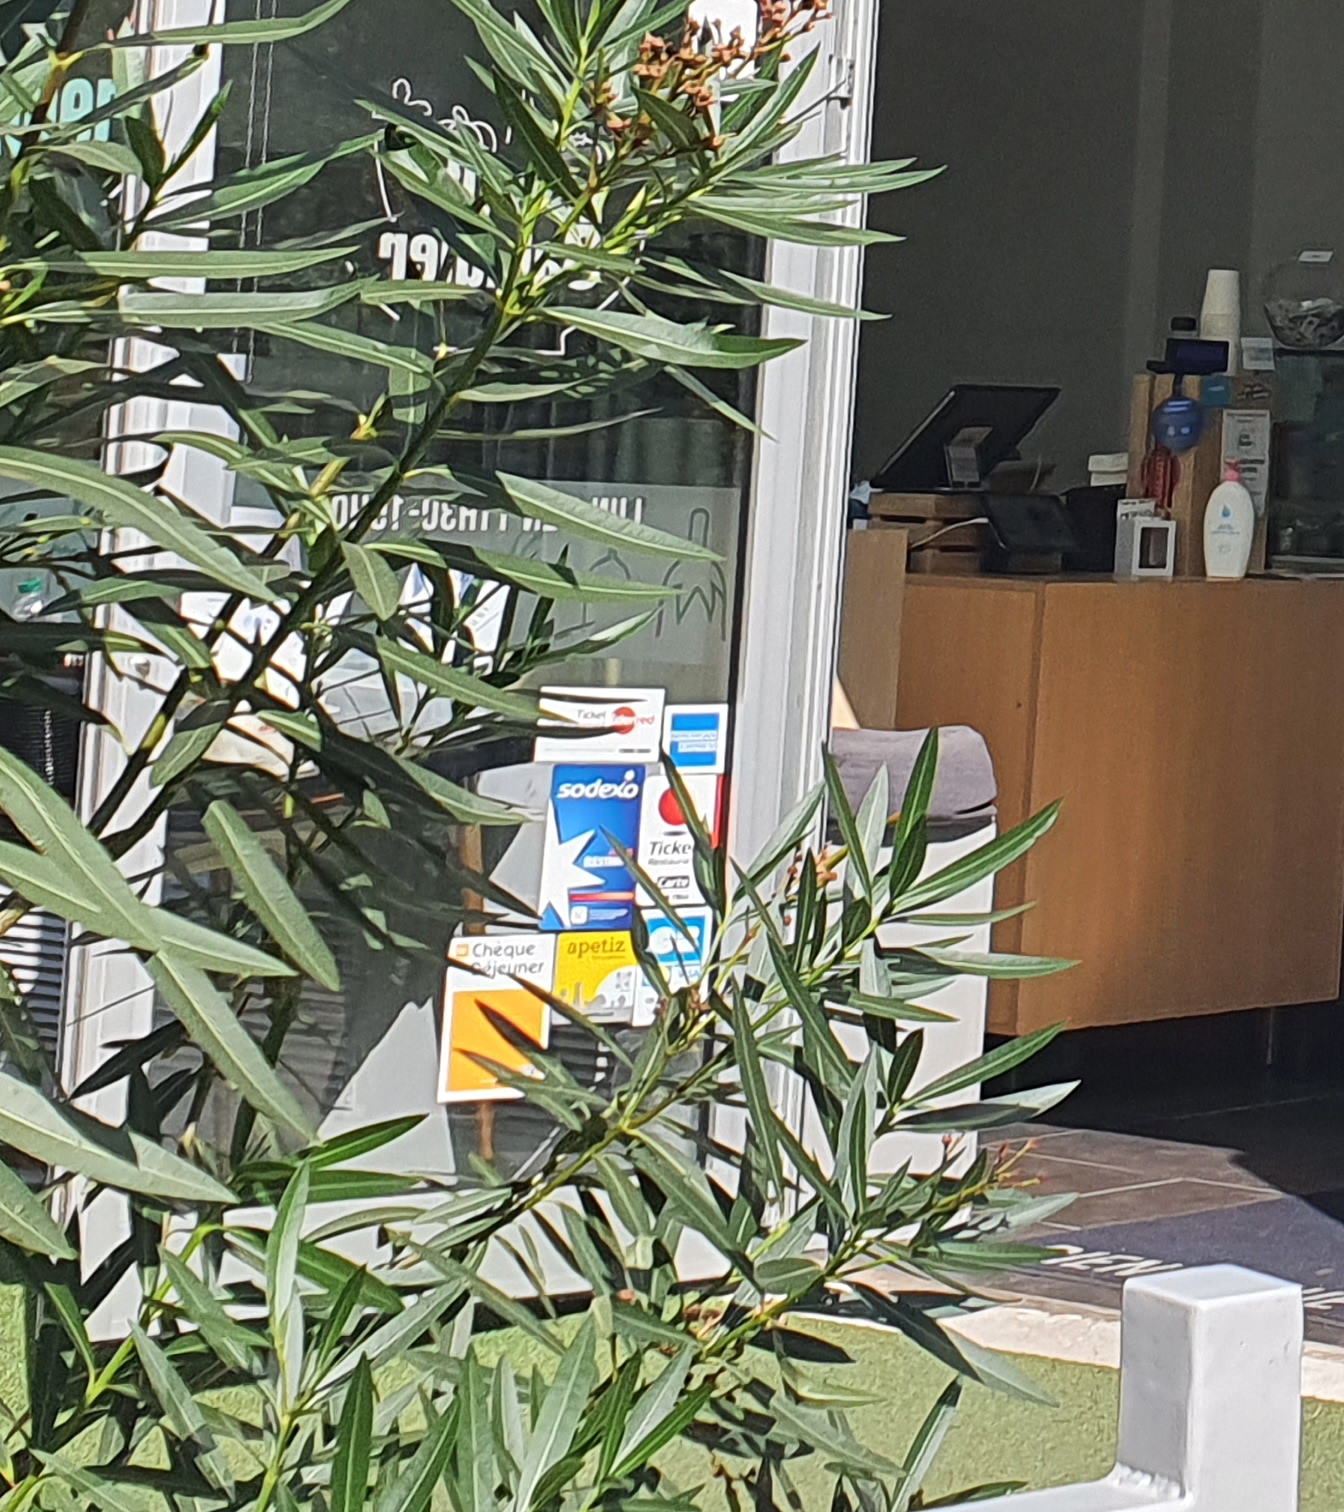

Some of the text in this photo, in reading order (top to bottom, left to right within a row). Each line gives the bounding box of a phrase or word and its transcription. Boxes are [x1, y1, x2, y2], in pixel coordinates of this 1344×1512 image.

[556, 770, 639, 800] sodexo
[650, 841, 692, 856] Ticke
[567, 938, 626, 957] apetiz
